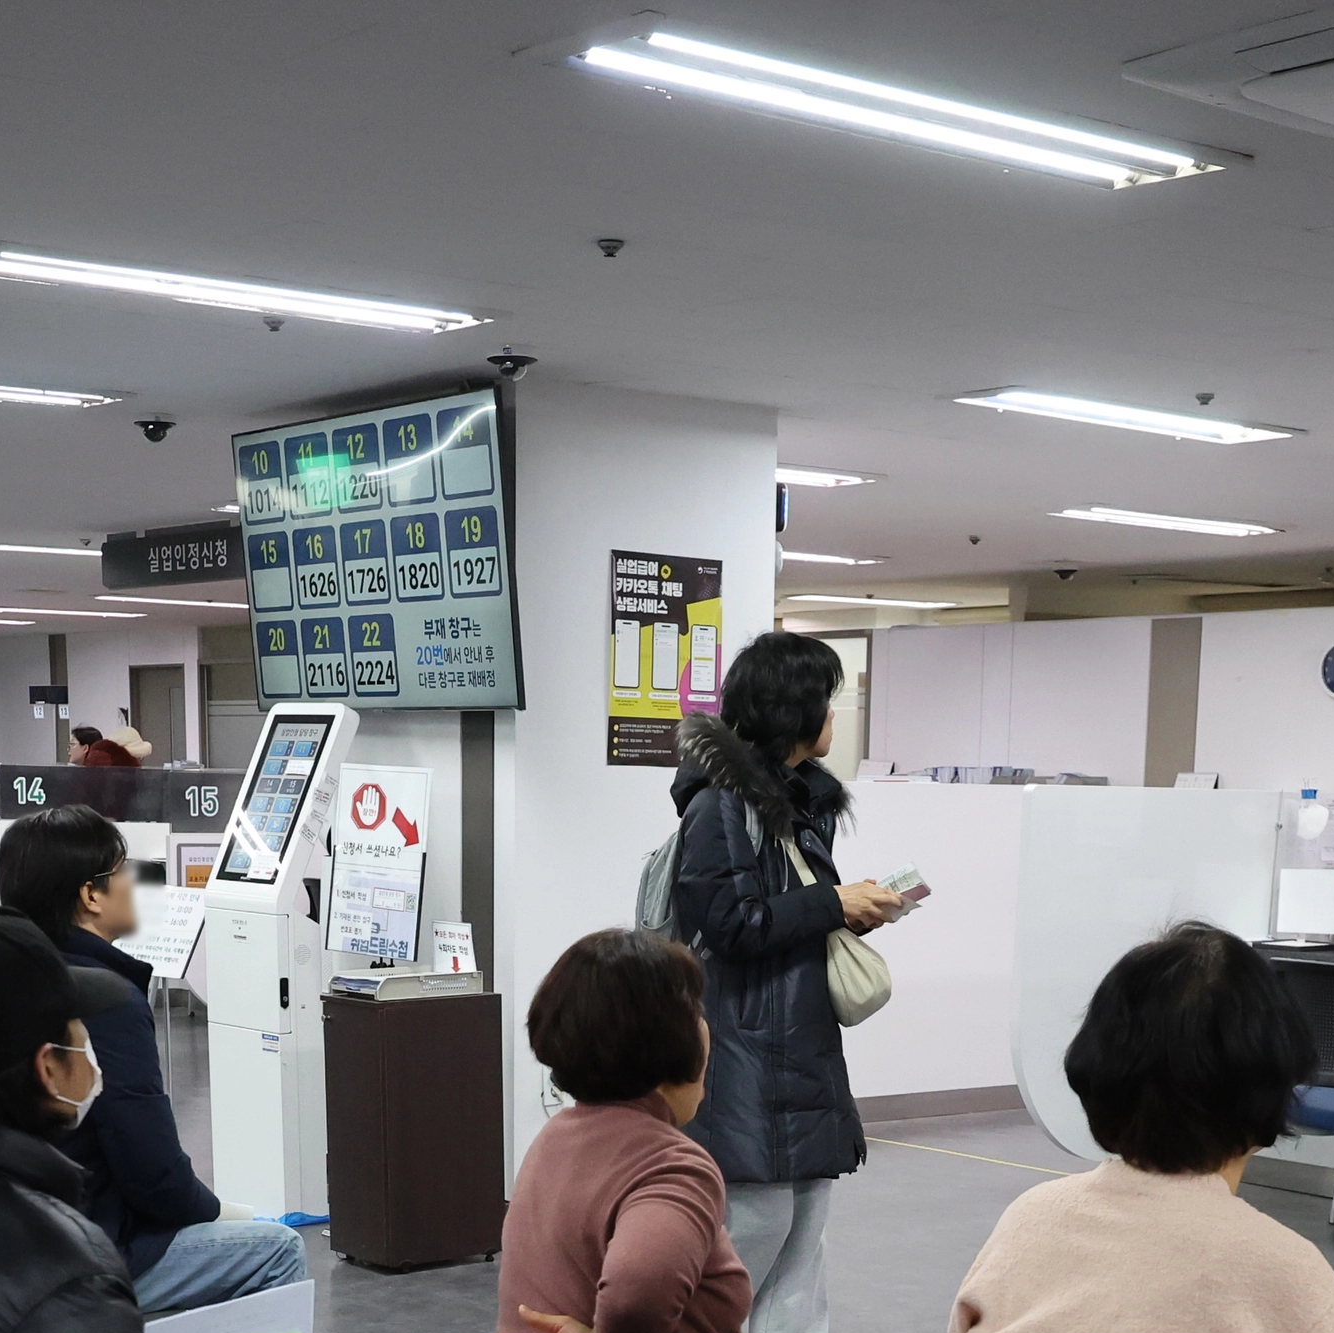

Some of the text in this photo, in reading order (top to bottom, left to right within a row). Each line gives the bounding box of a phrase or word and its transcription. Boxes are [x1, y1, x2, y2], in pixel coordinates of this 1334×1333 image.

[252, 416, 474, 475] 10 11 12 13 14
[248, 472, 379, 515] 1014 1112 1220
[260, 515, 482, 564] 15 16 17 18 19
[148, 538, 228, 573] 실업인정신청
[616, 558, 659, 577] 실업급여
[299, 556, 496, 599] 1626 1726 1820 1927
[616, 577, 683, 598] 카카오톡 채팅
[616, 596, 668, 615] 상담서비스
[268, 621, 381, 652] 20 21 22
[424, 617, 482, 640] 부재 창구는
[415, 644, 495, 666] 20번에서 안내 후
[307, 660, 395, 687] 2116 2224
[418, 669, 496, 689] 다른 창구로 재배정
[35, 707, 43, 715] 12
[60, 707, 67, 716] 13
[13, 776, 46, 805] 14
[185, 785, 219, 817] 15
[343, 841, 402, 859] 신청서 쓰셨나요?
